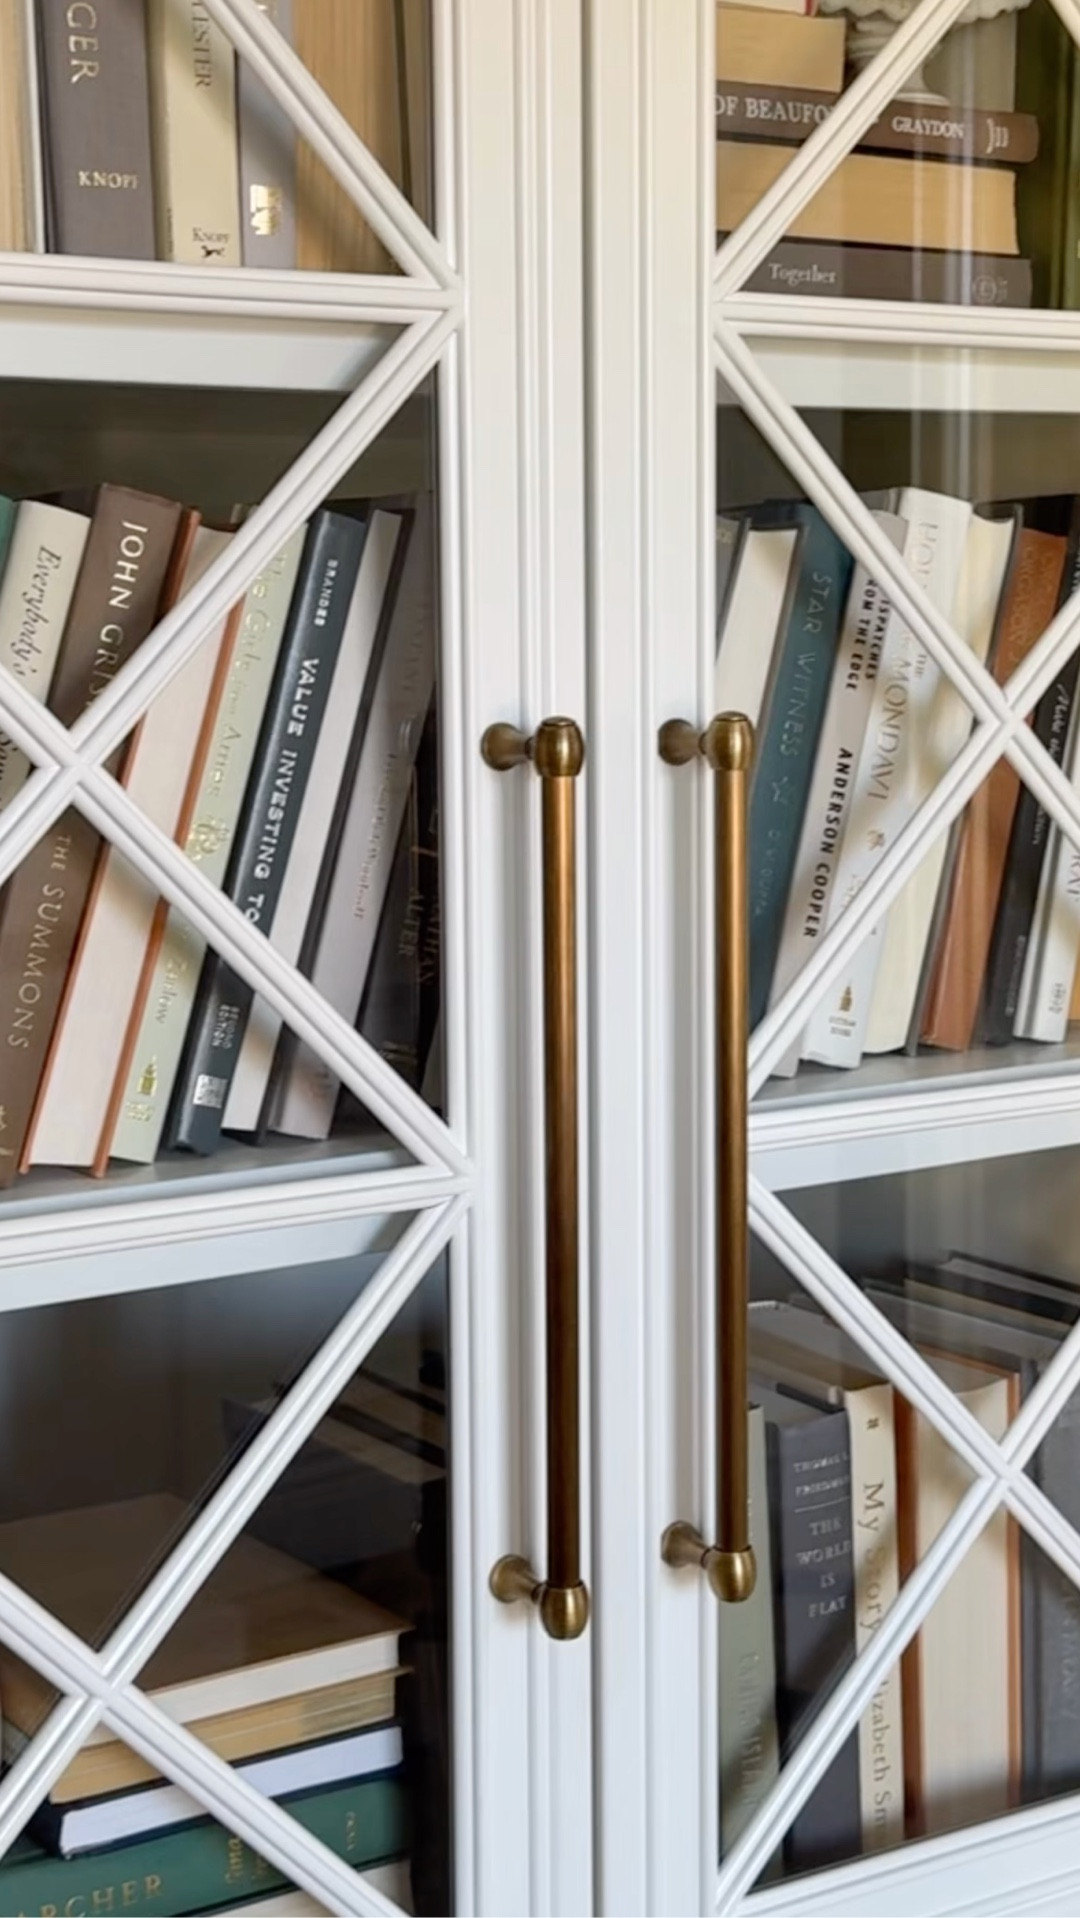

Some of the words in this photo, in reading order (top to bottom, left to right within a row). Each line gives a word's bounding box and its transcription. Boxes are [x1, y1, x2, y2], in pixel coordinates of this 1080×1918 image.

[745, 97, 838, 125] BEAUFO
[892, 116, 965, 140] GRAYDON
[768, 262, 837, 285] Together
[109, 520, 149, 610] JOHN
[313, 559, 339, 627] BRANDES
[860, 578, 876, 611] ROM
[802, 570, 833, 634] STAR
[854, 616, 871, 646] THE
[87, 623, 125, 709] GRIS
[288, 657, 320, 738] VALUE
[846, 652, 864, 690] EDGE
[779, 651, 817, 757] WITNESS
[867, 658, 914, 800] MONDAVI
[254, 750, 298, 880] INVESTING
[820, 747, 853, 853] ANDERSON
[50, 834, 72, 870] THE
[803, 862, 831, 938] COOPER
[8, 882, 65, 1049] SUMMONS
[858, 1481, 884, 1532] My
[808, 1594, 847, 1619] FLAT
[819, 1572, 836, 1589] IS
[871, 1680, 891, 1784] lizabeth
